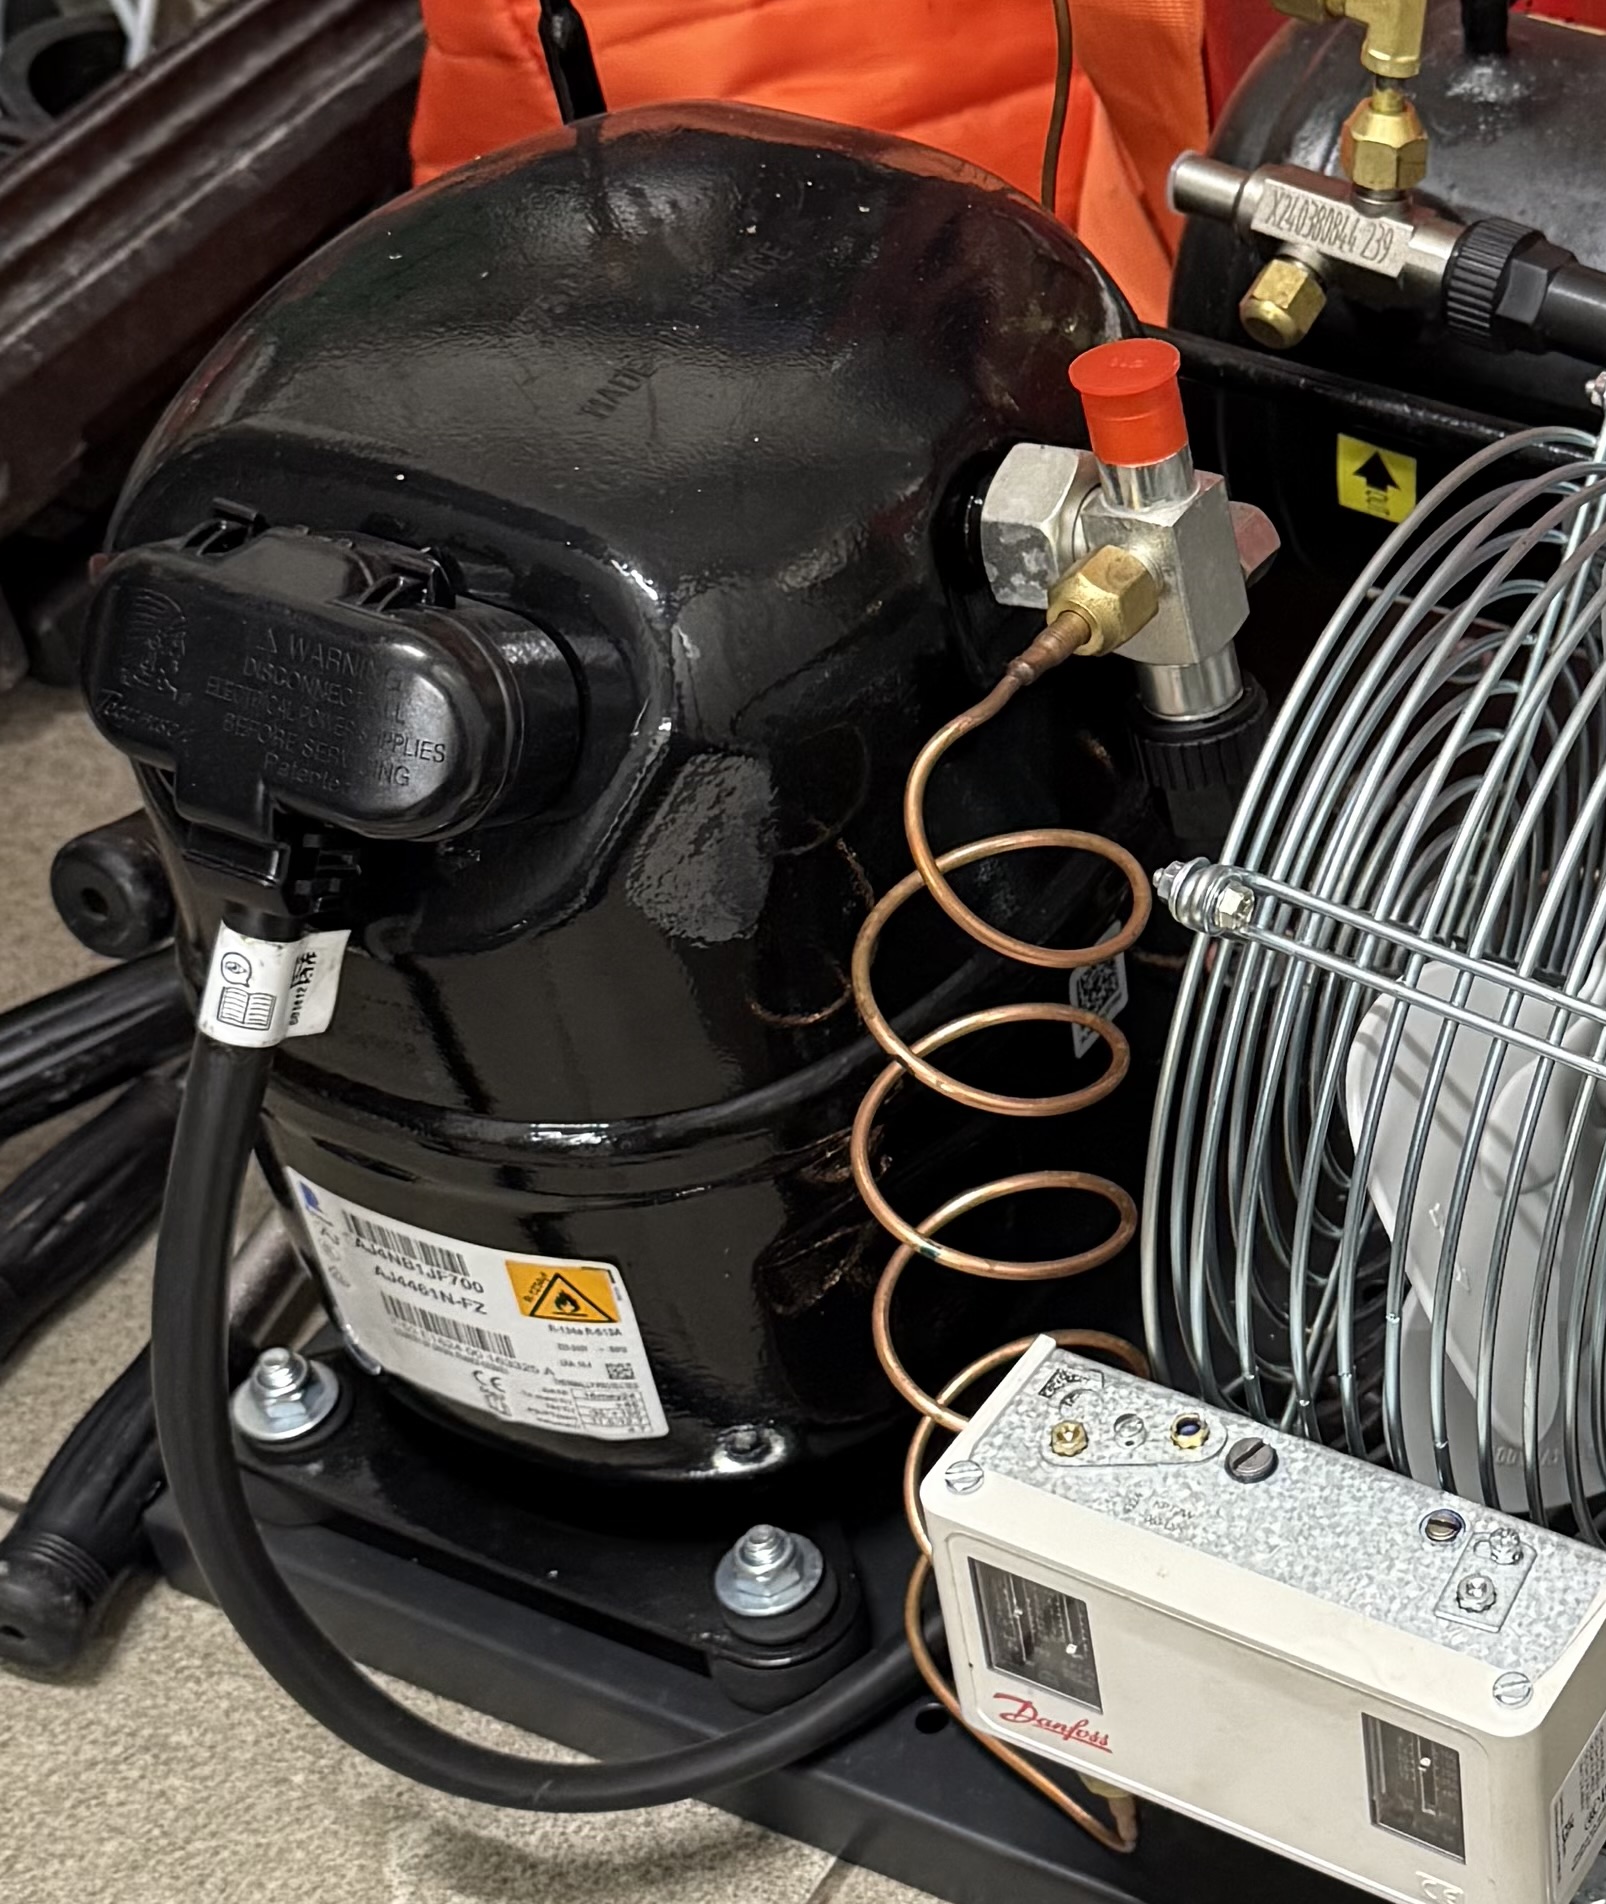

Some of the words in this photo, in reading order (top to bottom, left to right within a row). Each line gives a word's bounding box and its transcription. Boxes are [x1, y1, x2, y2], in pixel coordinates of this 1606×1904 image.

[1264, 189, 1362, 255] X240380844
[1359, 221, 1395, 265] 239
[222, 712, 297, 752] BEFORE
[356, 726, 447, 765] SPPLIES
[993, 1692, 1111, 1753] Danfoss
